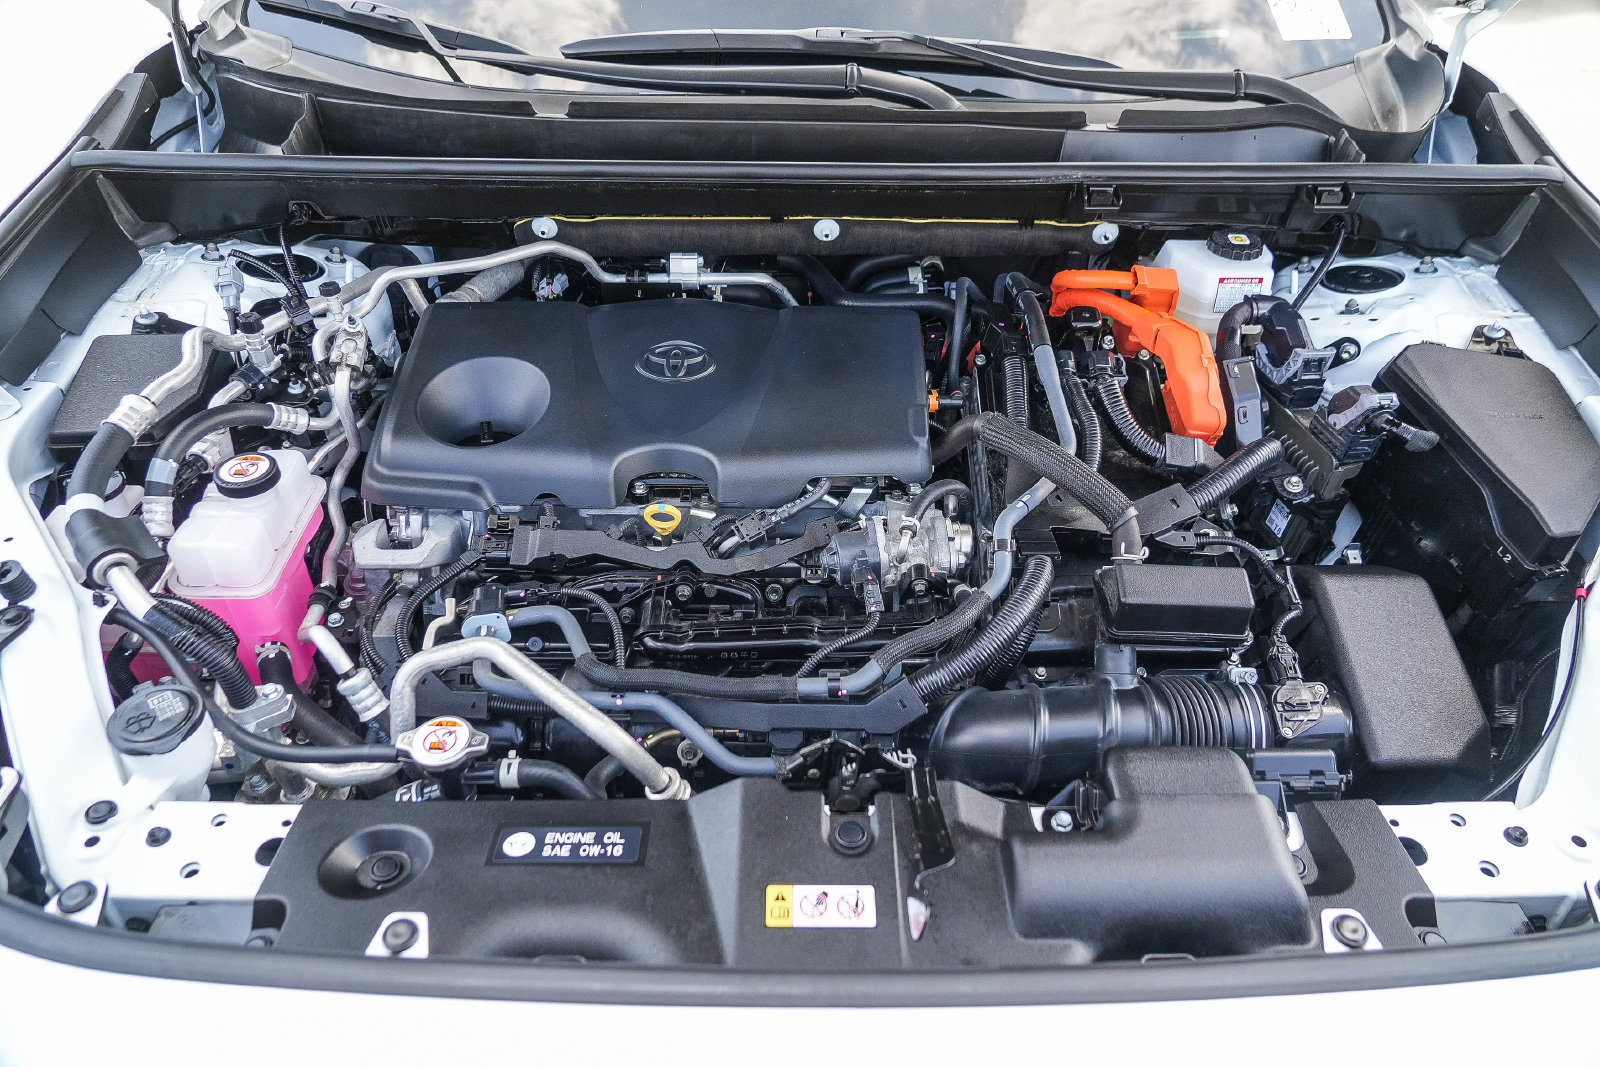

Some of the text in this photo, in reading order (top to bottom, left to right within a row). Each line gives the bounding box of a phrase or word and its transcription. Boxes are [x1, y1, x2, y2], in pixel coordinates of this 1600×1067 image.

[1496, 545, 1512, 564] L2
[544, 831, 625, 844] ENGINE OIL
[541, 844, 624, 857] SAE 0W-16
